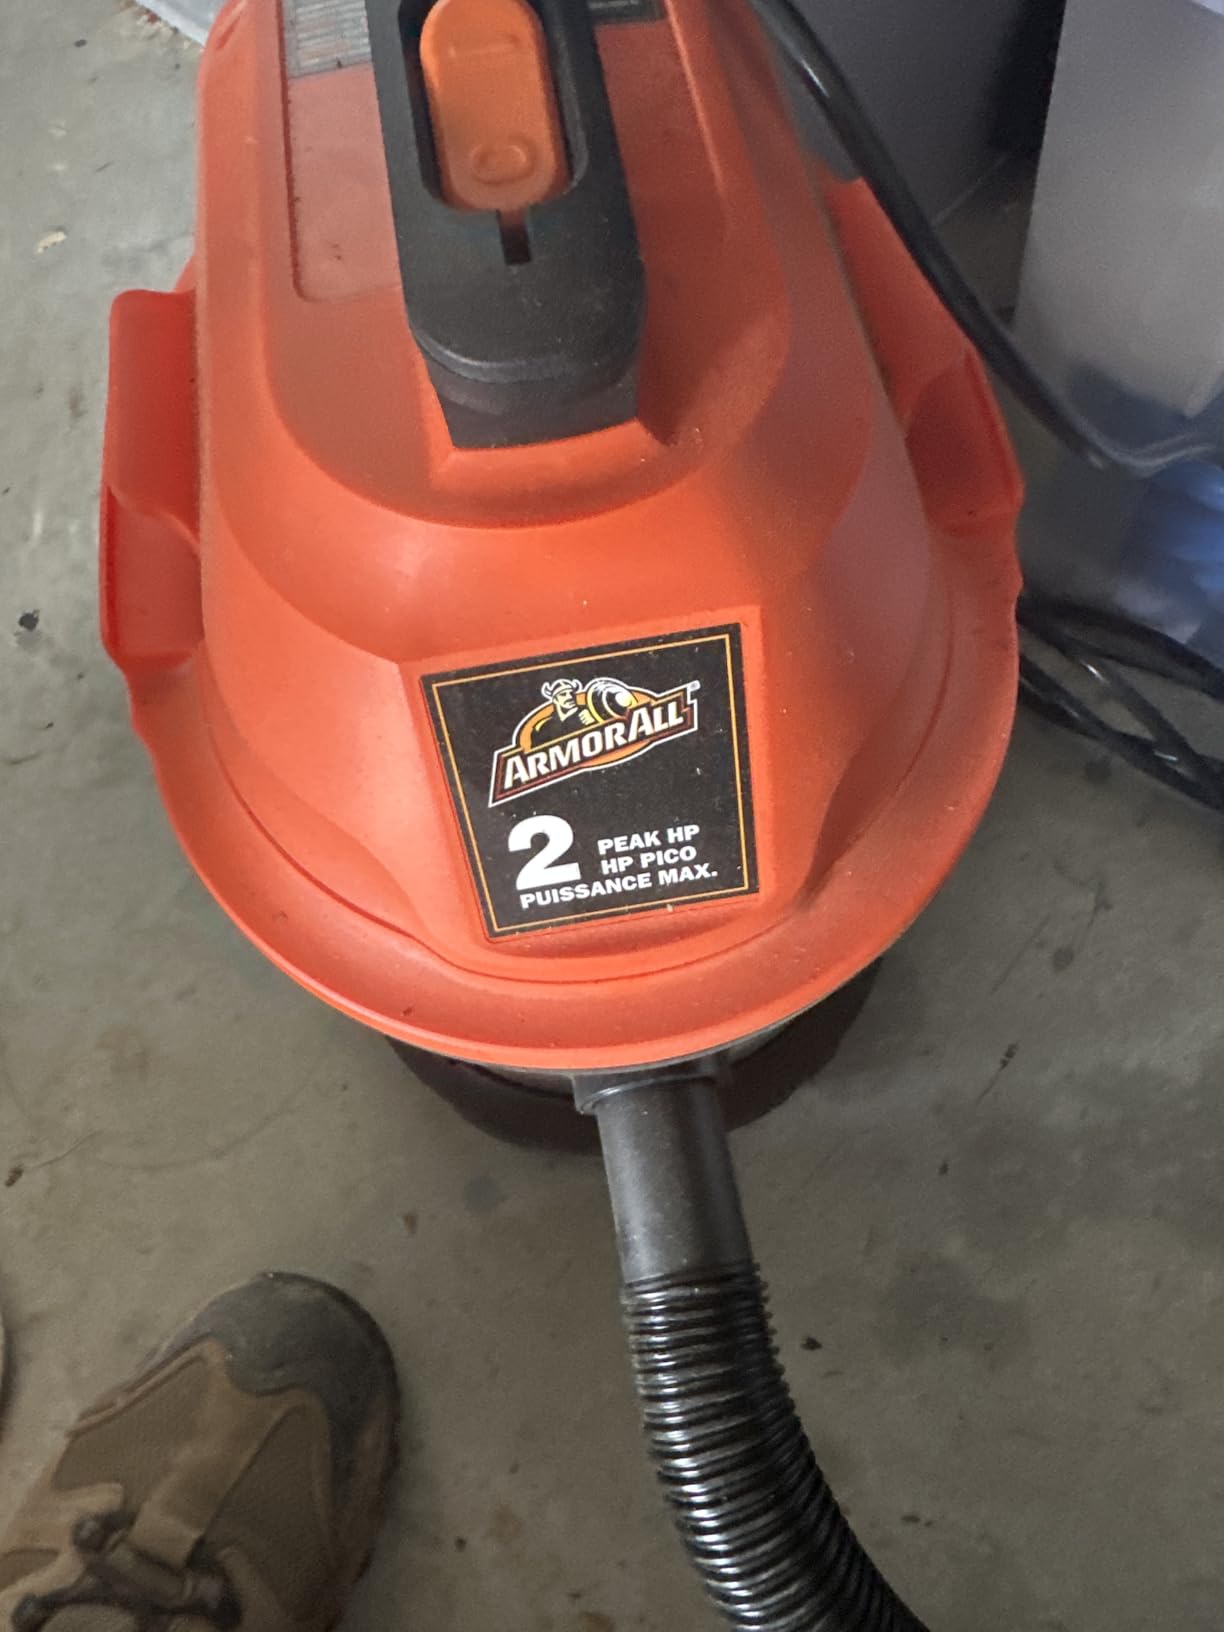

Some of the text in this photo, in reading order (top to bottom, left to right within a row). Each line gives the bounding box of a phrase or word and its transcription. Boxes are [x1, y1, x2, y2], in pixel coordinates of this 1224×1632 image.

[508, 815, 581, 890] 2
[598, 824, 700, 855] PEAK HP
[601, 845, 697, 875] HP PICO
[520, 863, 718, 909] PUISSANCE MAX.
